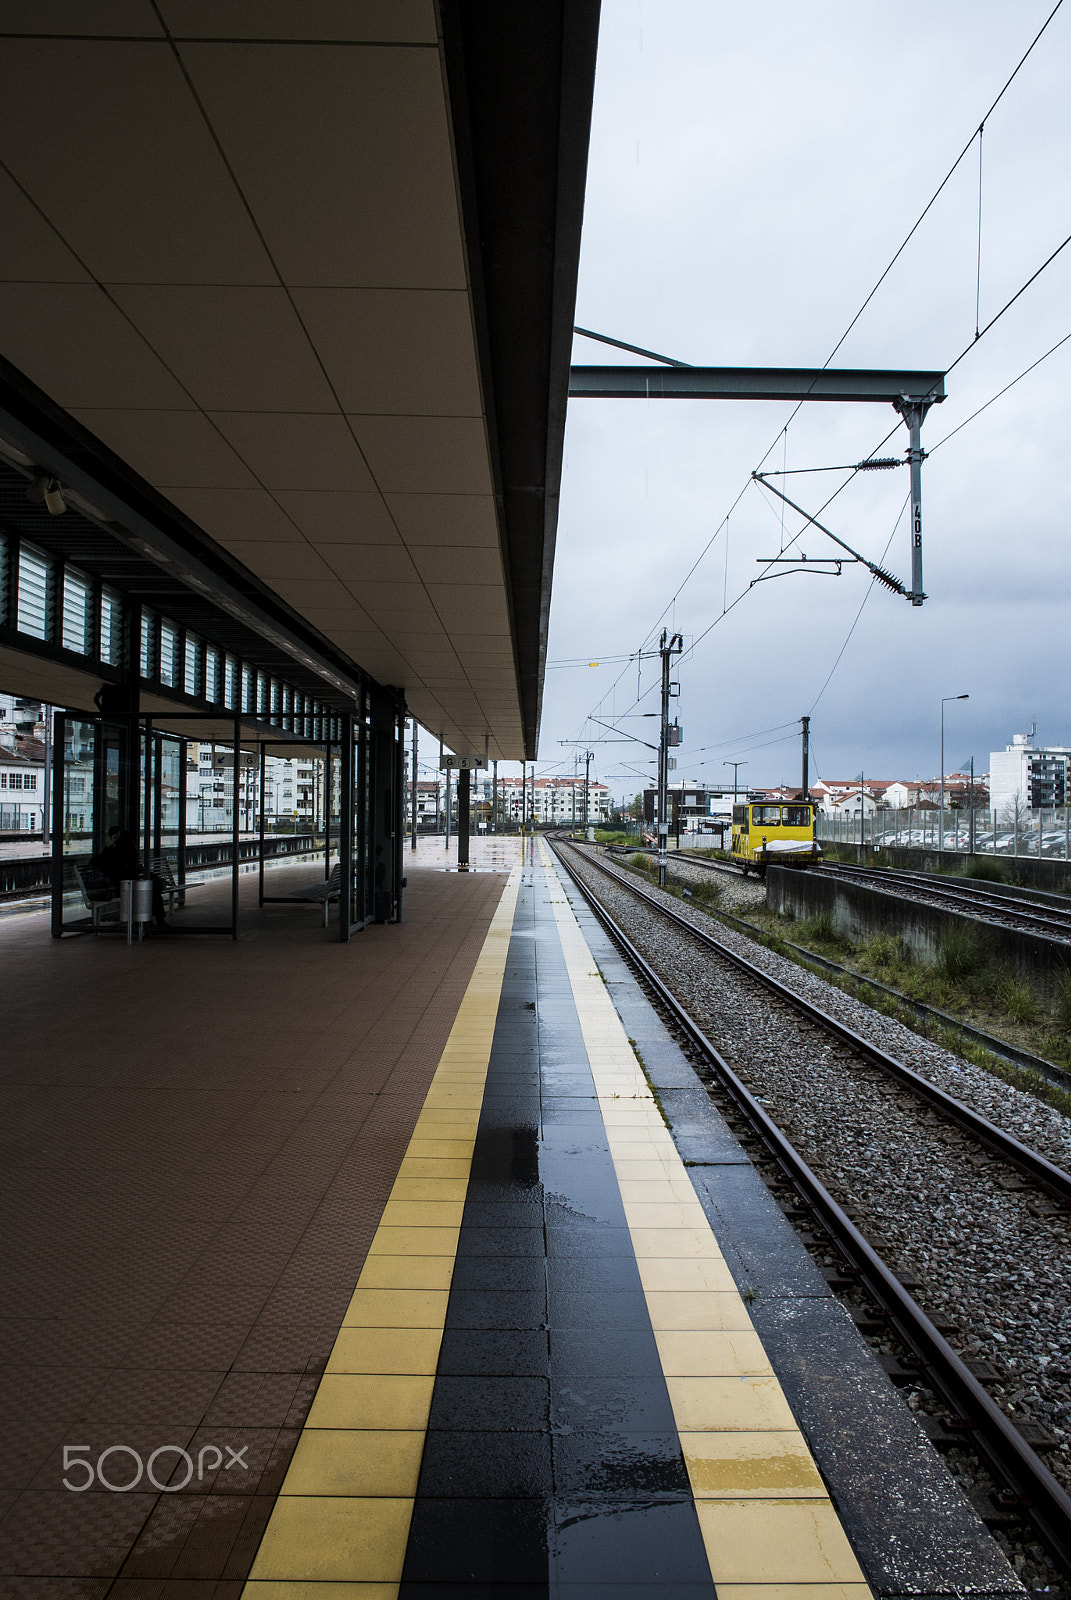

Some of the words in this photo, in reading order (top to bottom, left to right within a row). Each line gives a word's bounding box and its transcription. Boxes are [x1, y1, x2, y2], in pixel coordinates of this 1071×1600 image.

[914, 505, 922, 548] 40B
[446, 758, 454, 766] G
[461, 759, 467, 767] 5
